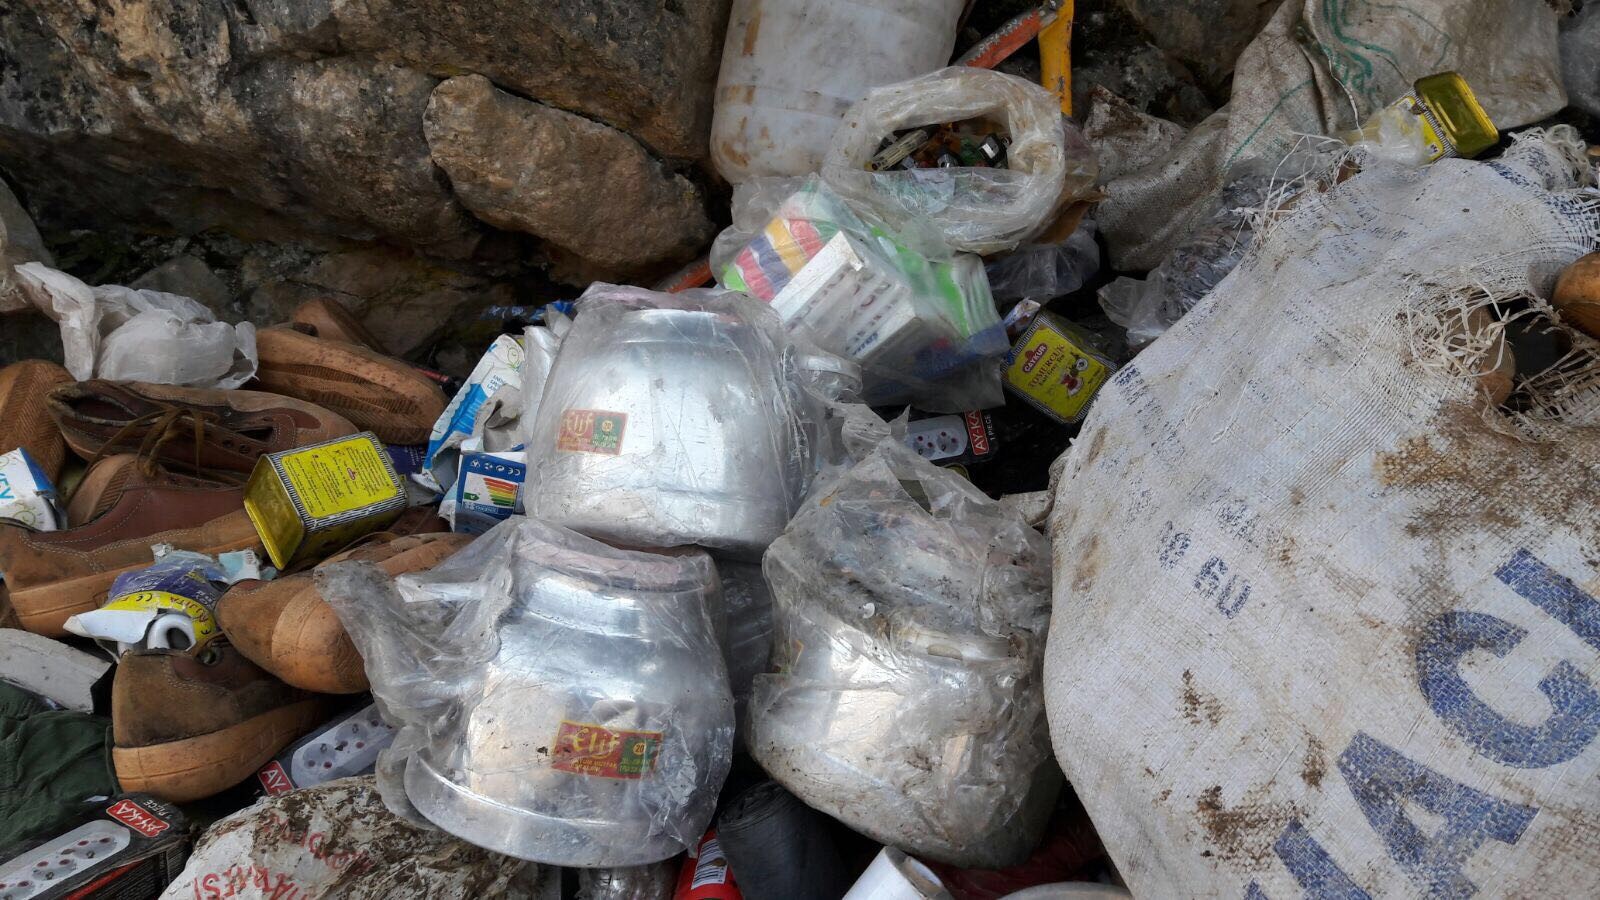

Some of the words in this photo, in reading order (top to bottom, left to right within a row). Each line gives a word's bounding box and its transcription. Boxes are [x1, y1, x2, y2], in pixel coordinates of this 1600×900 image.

[970, 411, 987, 452] AY-KA
[562, 727, 621, 758] Elif
[635, 743, 644, 753] 20
[115, 802, 162, 834] AY-KA
[144, 799, 167, 816] PIECE
